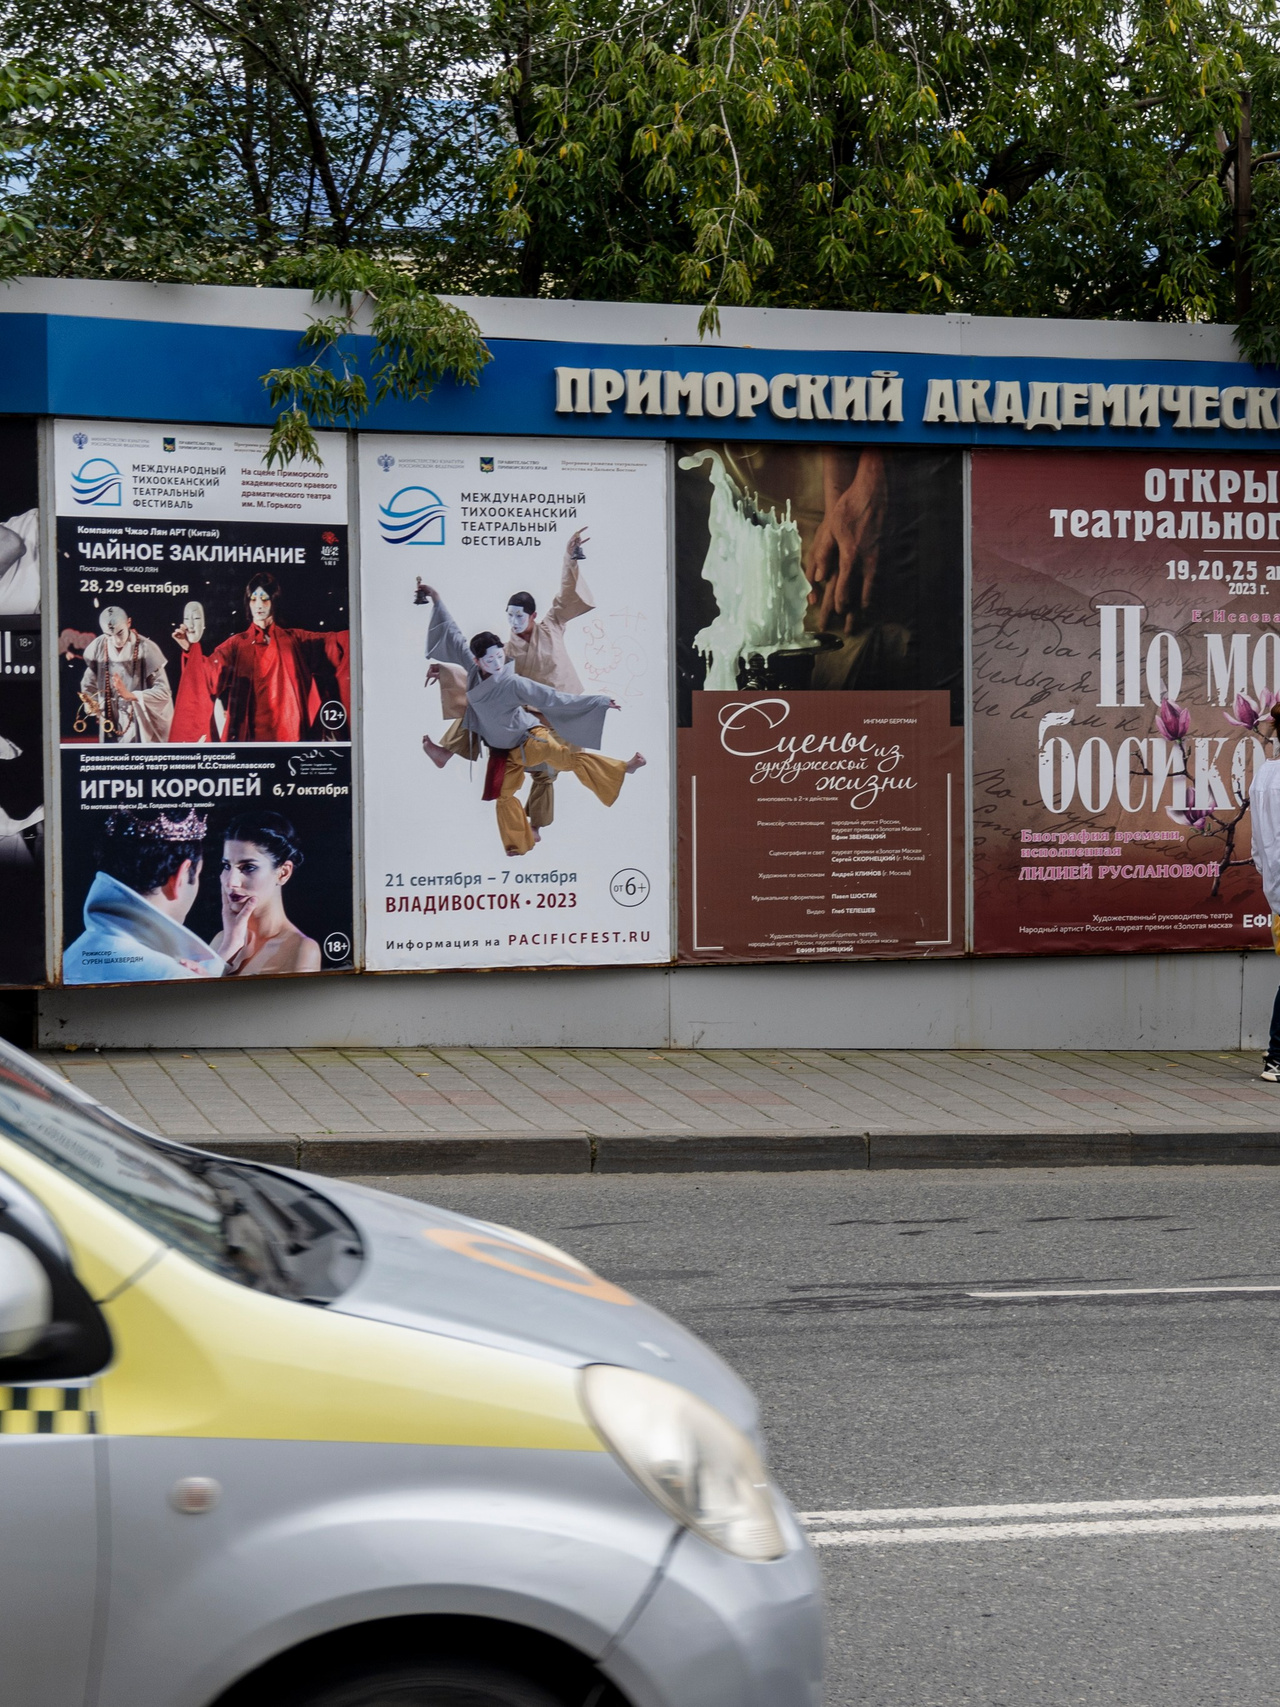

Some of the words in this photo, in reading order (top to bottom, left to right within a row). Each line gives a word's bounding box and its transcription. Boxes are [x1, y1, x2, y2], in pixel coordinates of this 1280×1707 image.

[554, 366, 903, 423] ПРИМОРСКИЙ
[132, 464, 226, 475] МЕЖДУНАРОДНЫЙ
[277, 470, 329, 479] Приморского
[132, 475, 220, 486] ТИХООКЕАНСКИЙ
[241, 480, 302, 488] академического
[133, 487, 205, 497] ТЕАТРАЛЬНЫЙ
[241, 491, 305, 499] драматического
[307, 493, 331, 501] театра
[461, 491, 586, 504] МЕЖДУНАРОДНЫЙ
[132, 499, 193, 509] ФЕСТИВАЛЬ
[462, 506, 577, 518] ТИХООКЕАНСКИЙ
[77, 526, 123, 535] Компания
[125, 527, 149, 535] Чжао
[150, 528, 168, 536] Лян
[169, 528, 186, 536] АРТ
[188, 529, 220, 538] (Китай)
[462, 520, 557, 532] ТЕАТРАЛЬНЫЙ
[461, 536, 541, 547] ФЕСТИВАЛЬ
[78, 539, 164, 561] ЧАЙНОЕ
[169, 543, 306, 565] ЗАКЛИНАНИЕ
[1166, 560, 1257, 582] 19,20,25
[80, 579, 102, 593] 28,
[106, 580, 124, 592] 29
[127, 581, 189, 596] сентября
[1228, 583, 1257, 596] 2023
[1260, 584, 1269, 596] г.
[19, 637, 33, 648] 18+
[1096, 605, 1183, 707] По
[323, 709, 344, 722] 12+
[718, 698, 876, 763] Сцены
[874, 744, 904, 772] из
[80, 754, 130, 762] Ереванский
[131, 754, 201, 763] государственный
[203, 753, 235, 762] русский
[146, 763, 168, 771] театр
[750, 757, 869, 784] супружеской
[81, 779, 143, 798] ИГРЫ
[151, 773, 261, 797] КОРОЛЕЙ
[297, 783, 348, 796] октября
[815, 774, 918, 810] жизни
[1021, 829, 1110, 844] Биография
[1115, 830, 1184, 842] времени,
[1021, 847, 1121, 858] исполненная
[1019, 863, 1092, 881] ЛИДИЕЙ
[1099, 862, 1220, 879] РУСЛАНОВОЙ
[386, 874, 404, 886] 21
[410, 872, 482, 888] сентября
[502, 871, 510, 884] 7
[515, 870, 577, 884] октября
[386, 893, 520, 914] ВЛАДИВОСТОК
[537, 892, 577, 909] 2023
[1092, 913, 1156, 923] Художественный
[1158, 913, 1208, 921] руководитель
[1019, 925, 1058, 933] Народный
[1060, 925, 1083, 933] артист
[1085, 924, 1114, 932] России,
[1115, 924, 1143, 932] лауреат
[386, 938, 479, 951] Информация
[485, 938, 500, 946] на
[508, 930, 650, 946] PACIFICFEST.RU
[327, 941, 347, 953] 18+
